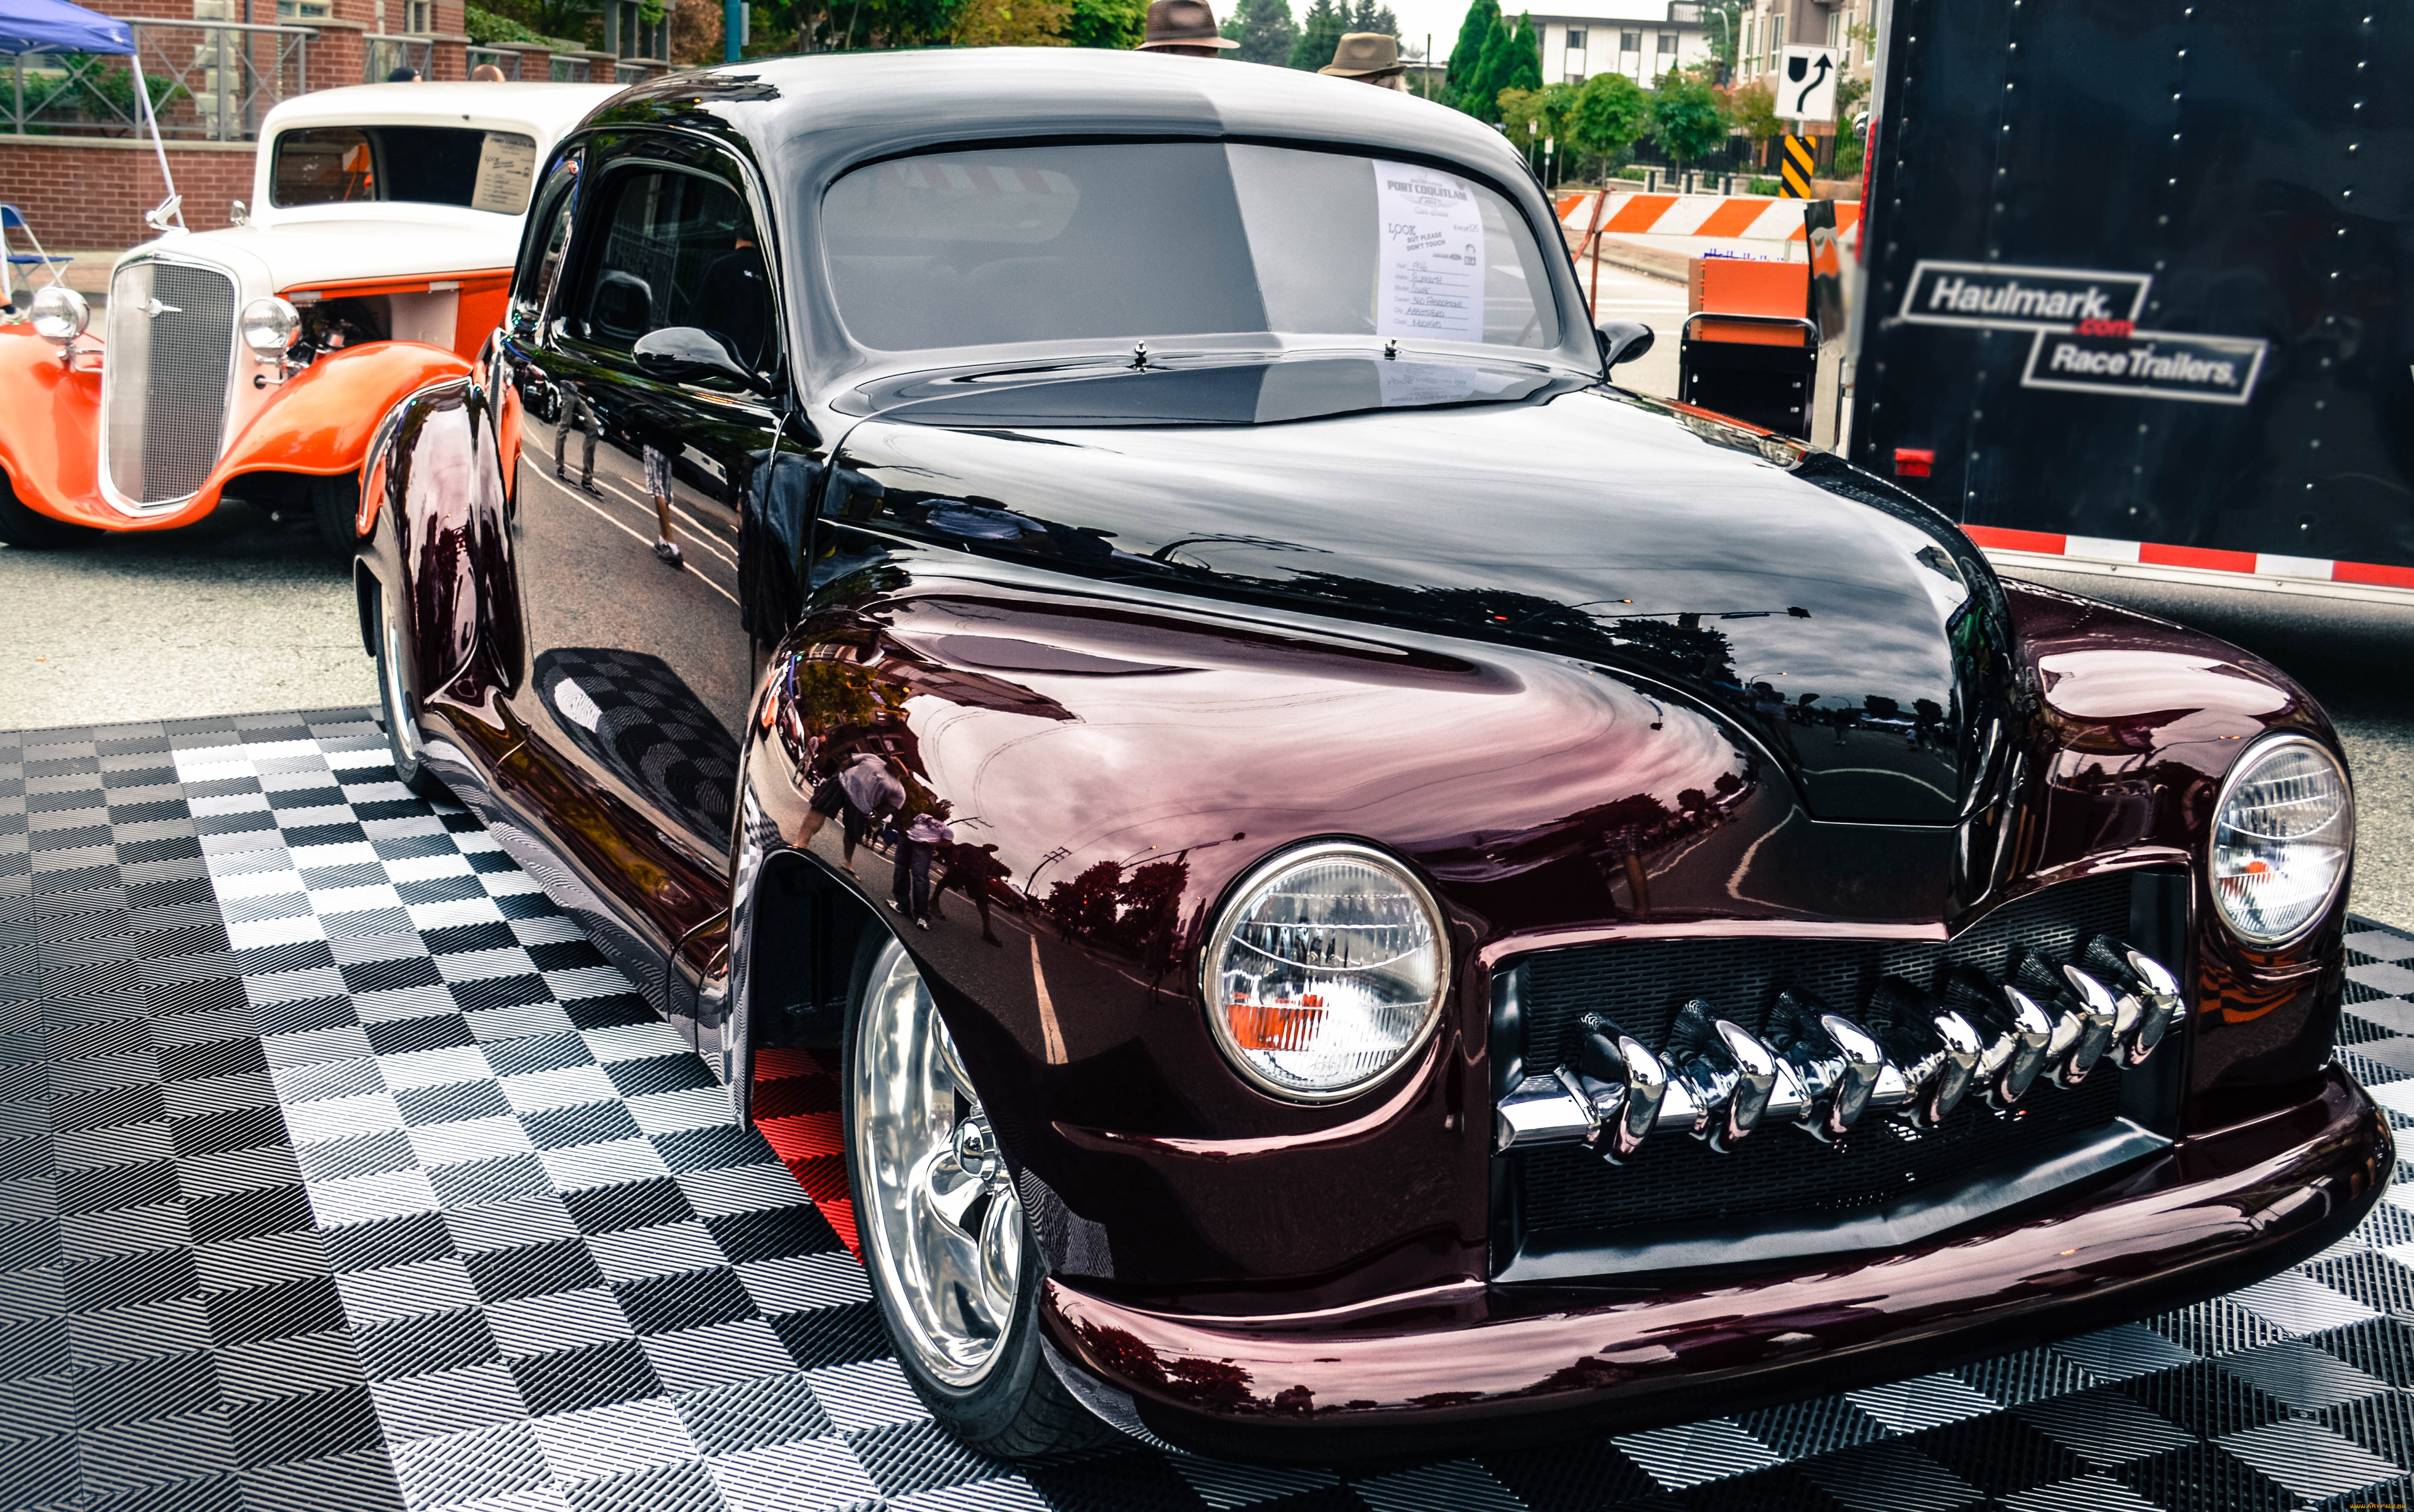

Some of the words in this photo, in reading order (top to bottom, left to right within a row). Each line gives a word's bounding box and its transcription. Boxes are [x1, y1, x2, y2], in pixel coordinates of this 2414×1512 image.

[1387, 181, 1412, 192] PORT
[1388, 222, 1416, 236] LOOK
[2073, 318, 2135, 339] .com
